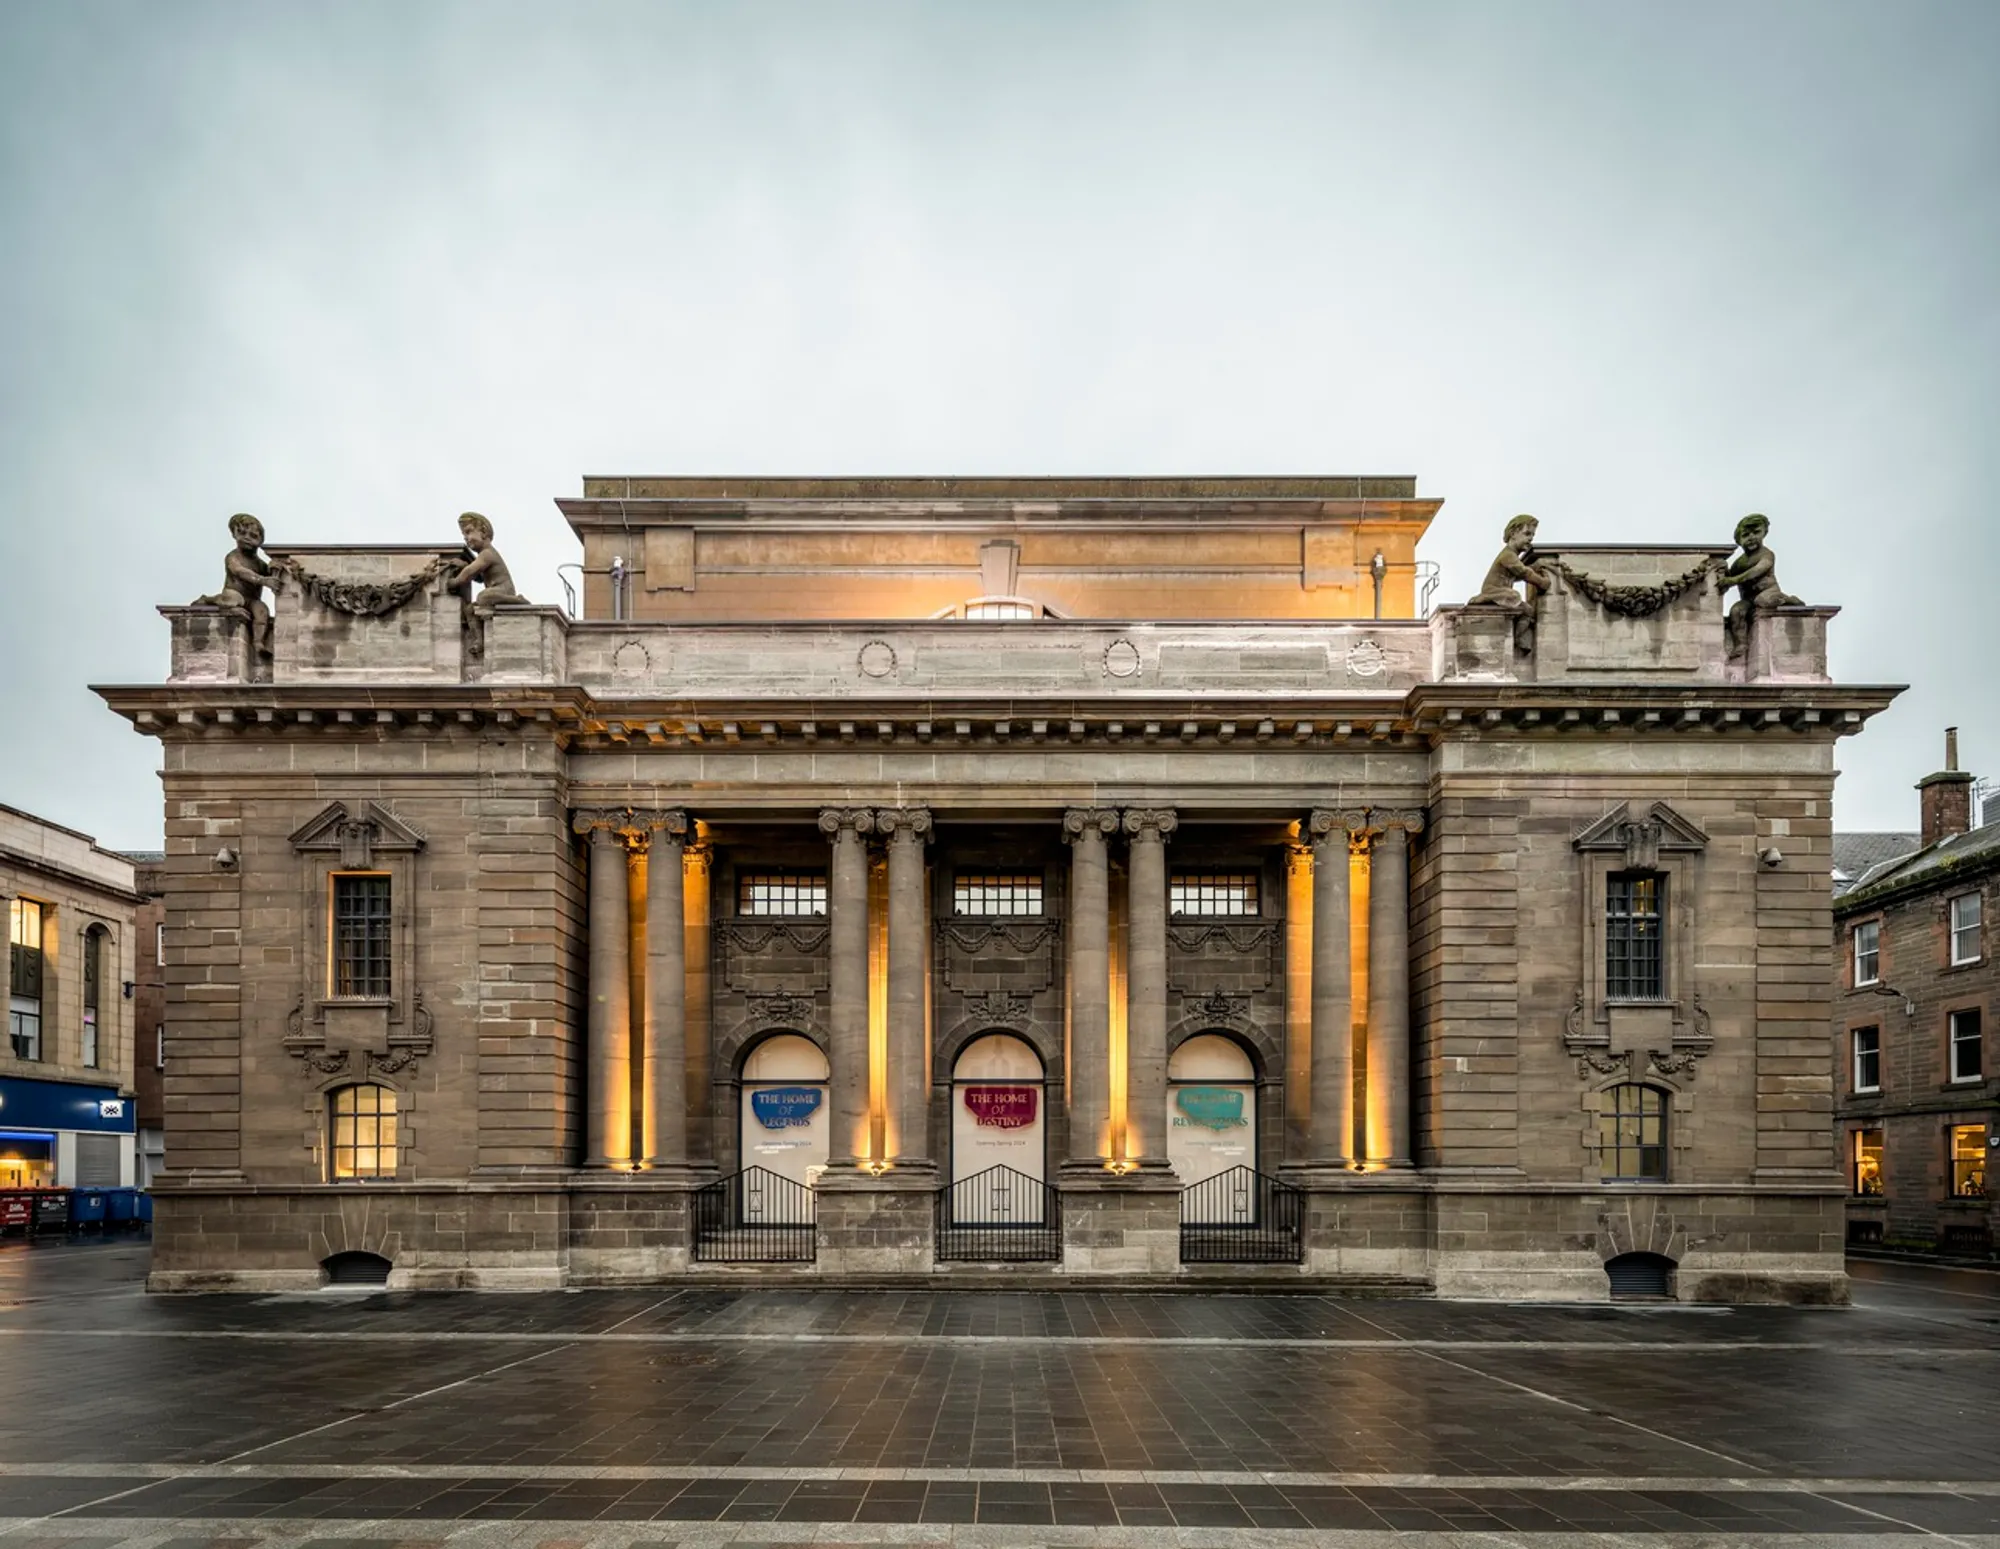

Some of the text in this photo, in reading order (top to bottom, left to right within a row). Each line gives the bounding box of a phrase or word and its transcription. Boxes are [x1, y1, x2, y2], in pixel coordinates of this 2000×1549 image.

[758, 1094, 815, 1104] THE HOME
[970, 1093, 1028, 1104] THE HOME
[778, 1106, 795, 1115] OF
[991, 1105, 1006, 1115] OF
[764, 1117, 812, 1127] LEGENDS
[977, 1116, 1023, 1126] DESTINY
